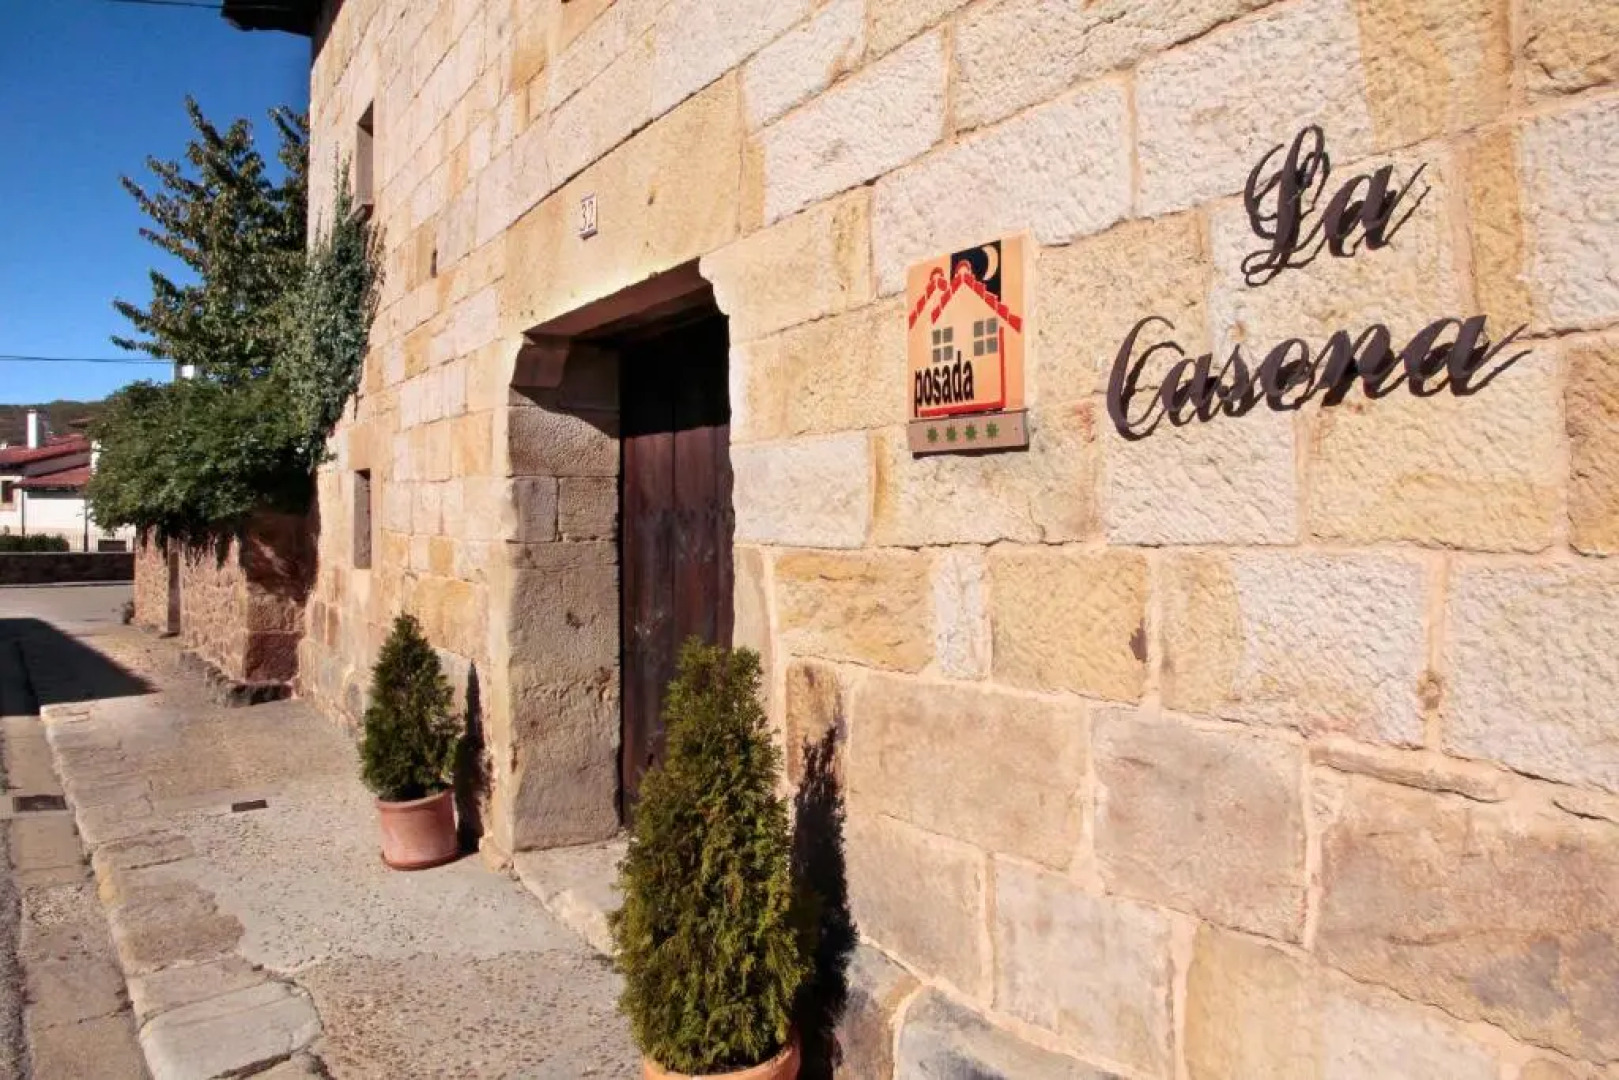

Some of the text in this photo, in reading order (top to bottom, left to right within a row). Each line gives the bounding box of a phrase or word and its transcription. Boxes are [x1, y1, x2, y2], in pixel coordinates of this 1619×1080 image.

[1241, 124, 1430, 284] La
[914, 350, 974, 418] posada
[1107, 315, 1530, 440] Casona
